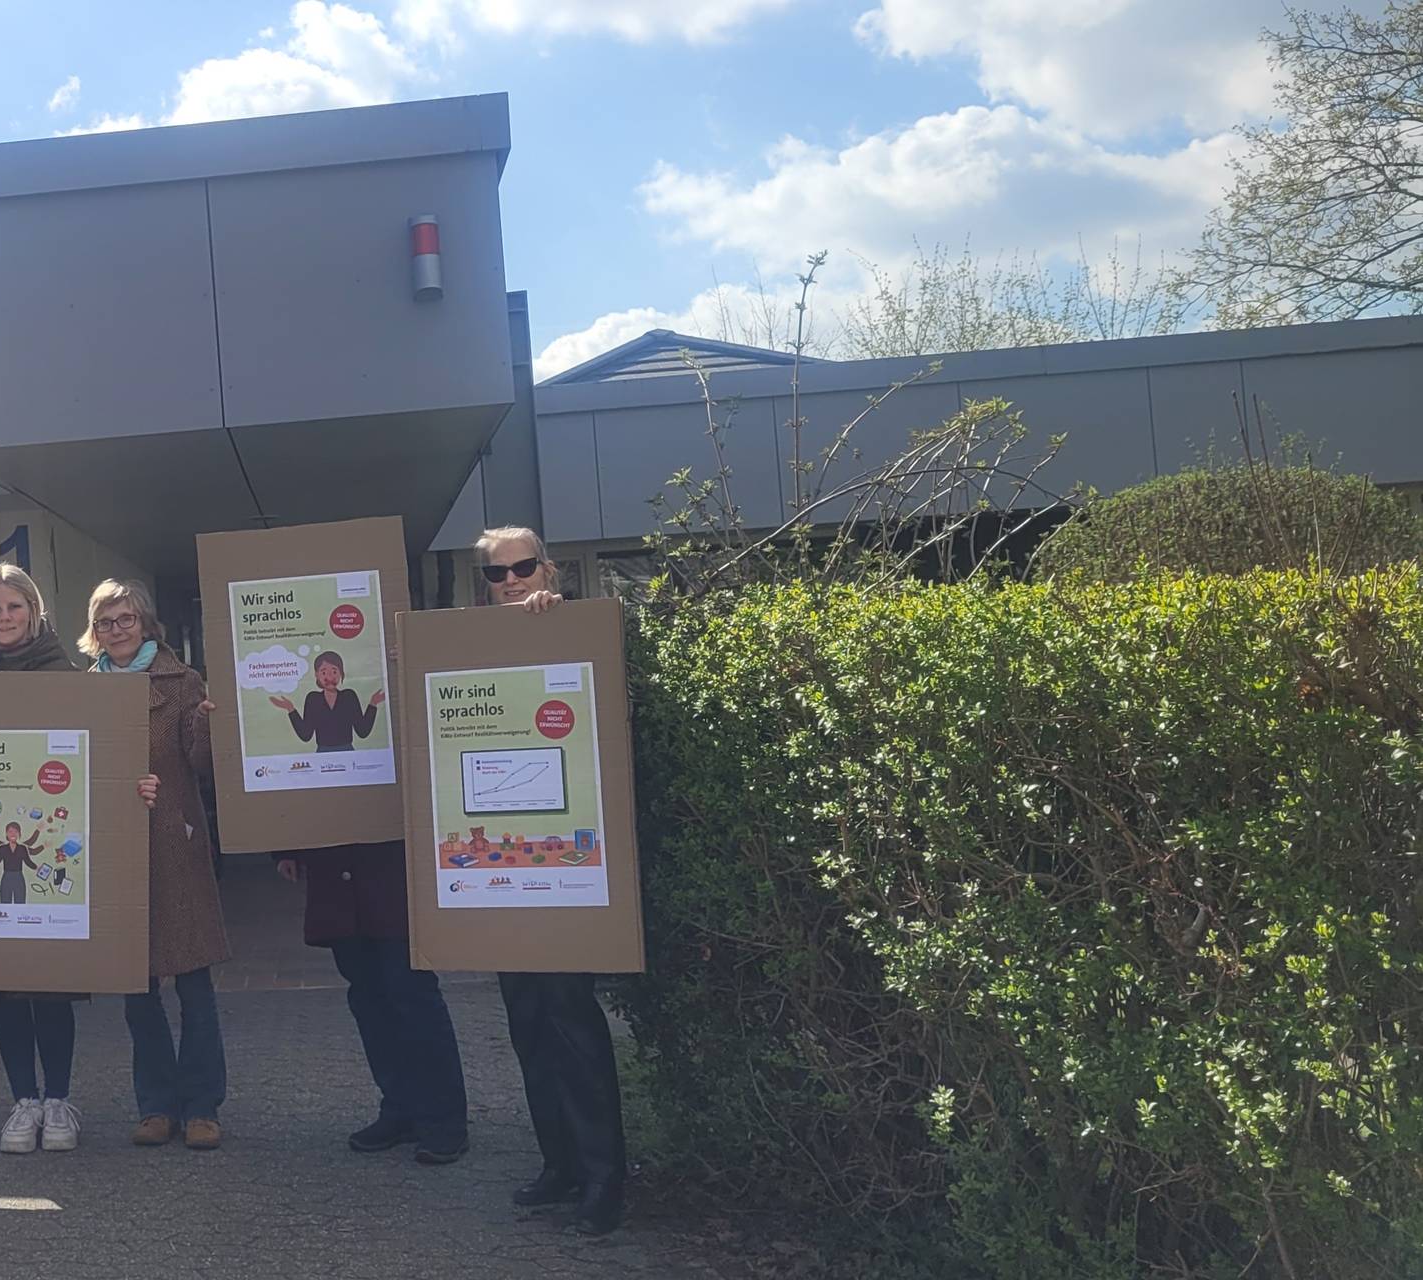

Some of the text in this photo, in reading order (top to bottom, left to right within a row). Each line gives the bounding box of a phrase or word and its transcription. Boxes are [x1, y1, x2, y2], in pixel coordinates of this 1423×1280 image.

[241, 590, 293, 606] Wir sind
[243, 607, 301, 626] sprachlos
[249, 661, 297, 670] Fachkompetenz
[266, 670, 298, 678] erwünscht
[439, 683, 496, 700] Wir sind
[440, 702, 504, 722] sprachlos
